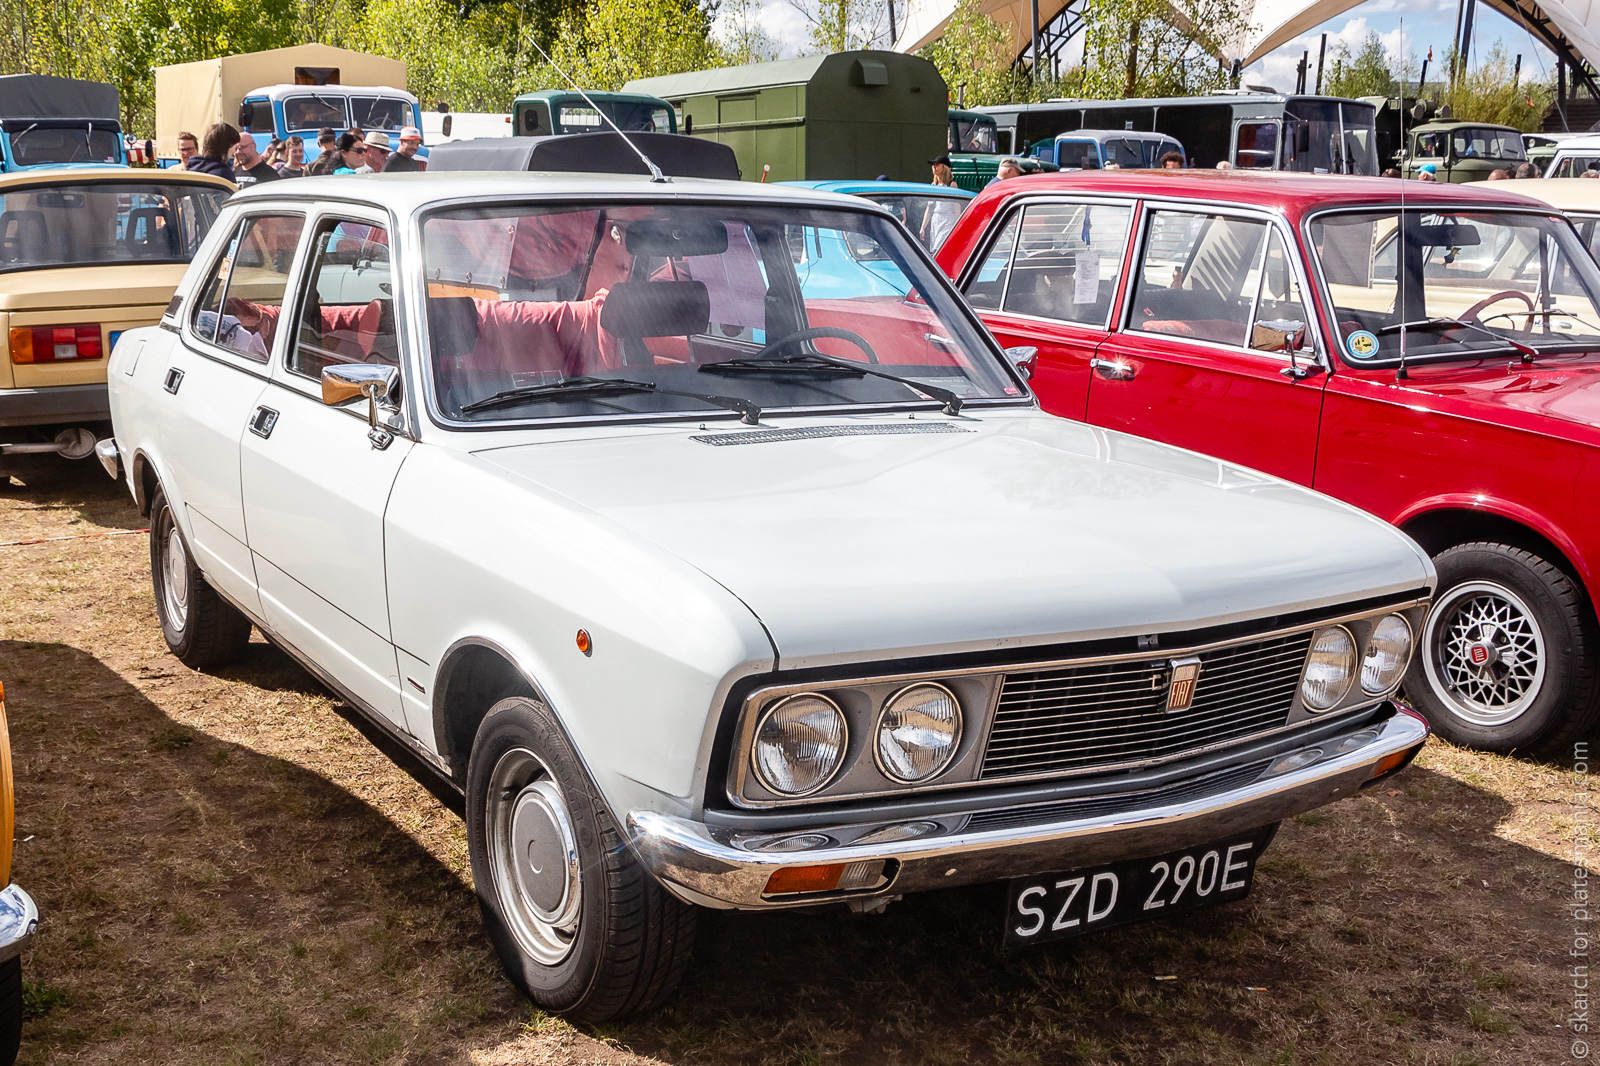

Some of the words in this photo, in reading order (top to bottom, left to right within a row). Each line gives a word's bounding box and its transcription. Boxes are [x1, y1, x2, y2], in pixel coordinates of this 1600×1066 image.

[1169, 680, 1193, 708] FIAT
[1014, 871, 1119, 937] SZD
[1143, 842, 1253, 910] 290E
